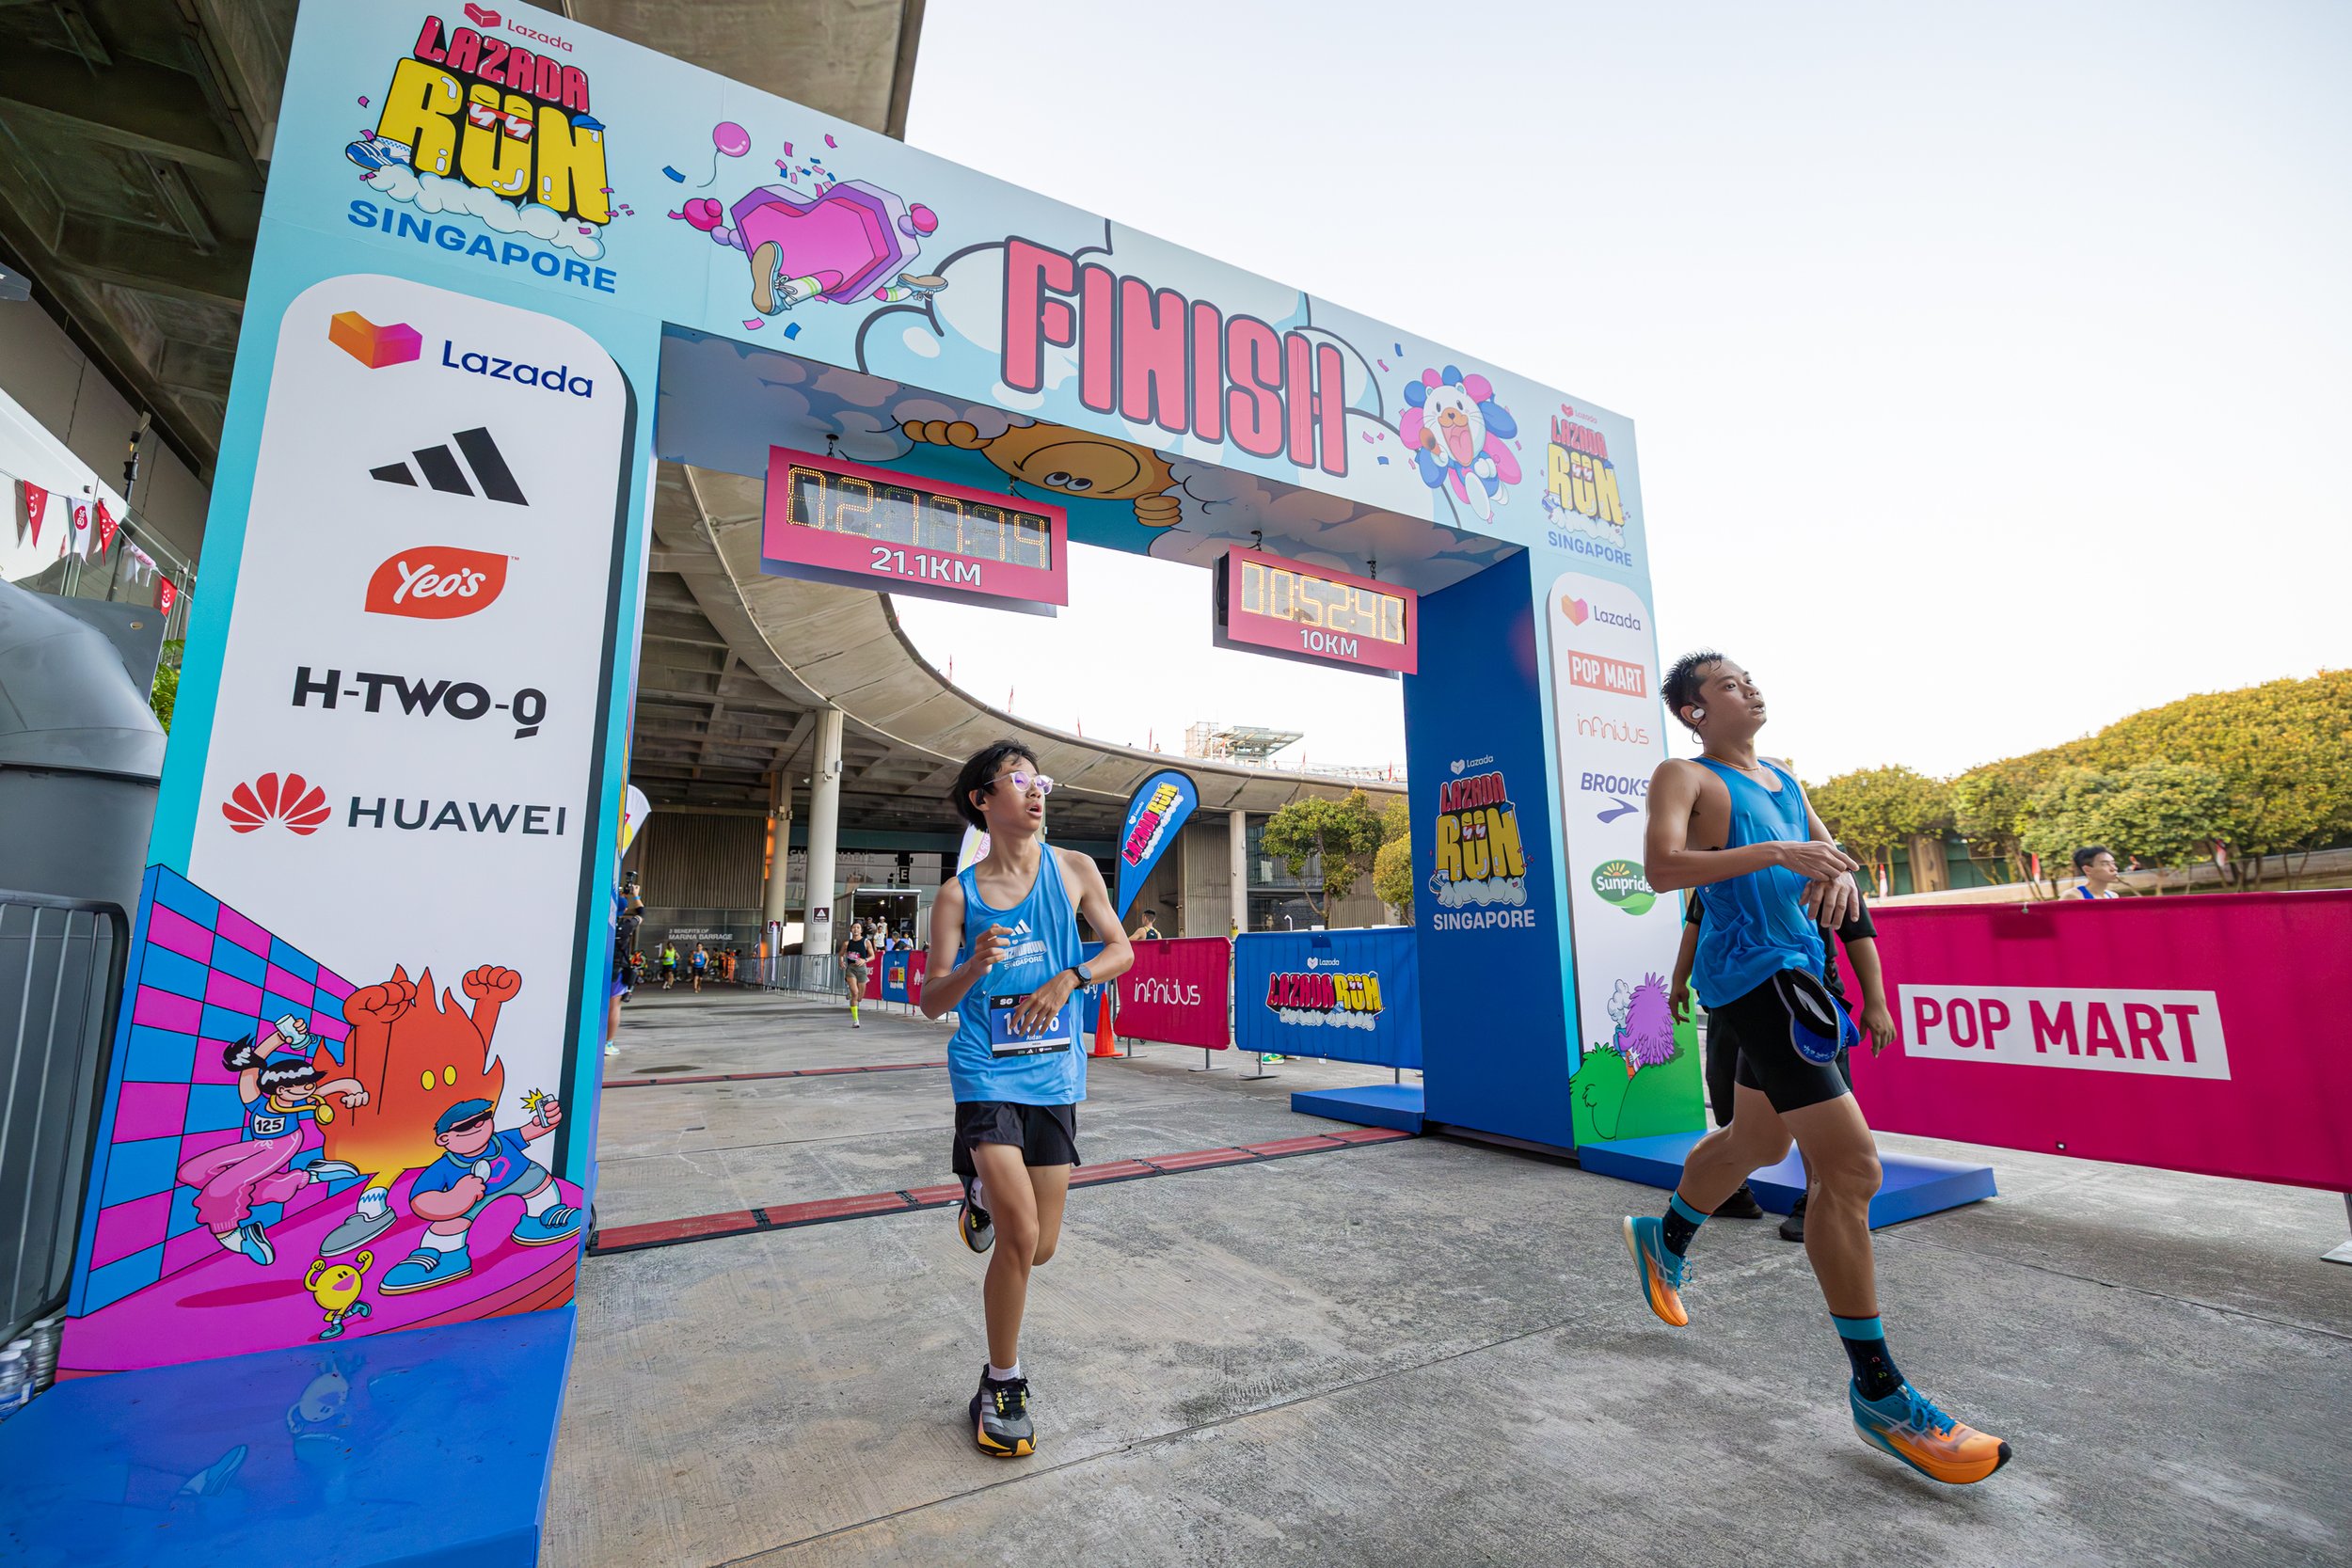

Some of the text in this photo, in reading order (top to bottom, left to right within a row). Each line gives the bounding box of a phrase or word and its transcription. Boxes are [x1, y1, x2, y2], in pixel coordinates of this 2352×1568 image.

[508, 19, 573, 53] Lazada
[414, 15, 590, 114] LAZADA
[375, 56, 612, 227] RUN
[347, 199, 617, 293] SINGAPORE
[441, 340, 594, 398] Lazada
[1000, 235, 1349, 478] FINISH
[1550, 414, 1608, 460] LAZADA
[870, 546, 982, 586] 21.1KM
[1548, 531, 1633, 566] SINGAPORE
[393, 561, 485, 604] Yeo's
[1241, 561, 1403, 644] 00:52:40
[1594, 605, 1642, 631] Lazada
[1300, 629, 1358, 658] 10KM
[1571, 656, 1643, 693] POP MART
[1467, 754, 1494, 768] Lazada
[1441, 772, 1505, 813] LAZADA
[1581, 772, 1650, 797] BROOKS
[348, 796, 566, 835] HUAWEI
[1121, 810, 1160, 866] LAZADA
[1597, 875, 1654, 896] Sunpride
[1433, 909, 1536, 931] SINGAPORE
[1319, 958, 1340, 966] Lazada
[1266, 973, 1335, 1008] LAZADA
[1913, 996, 2200, 1063] POP MART
[256, 1119, 281, 1132] 125
